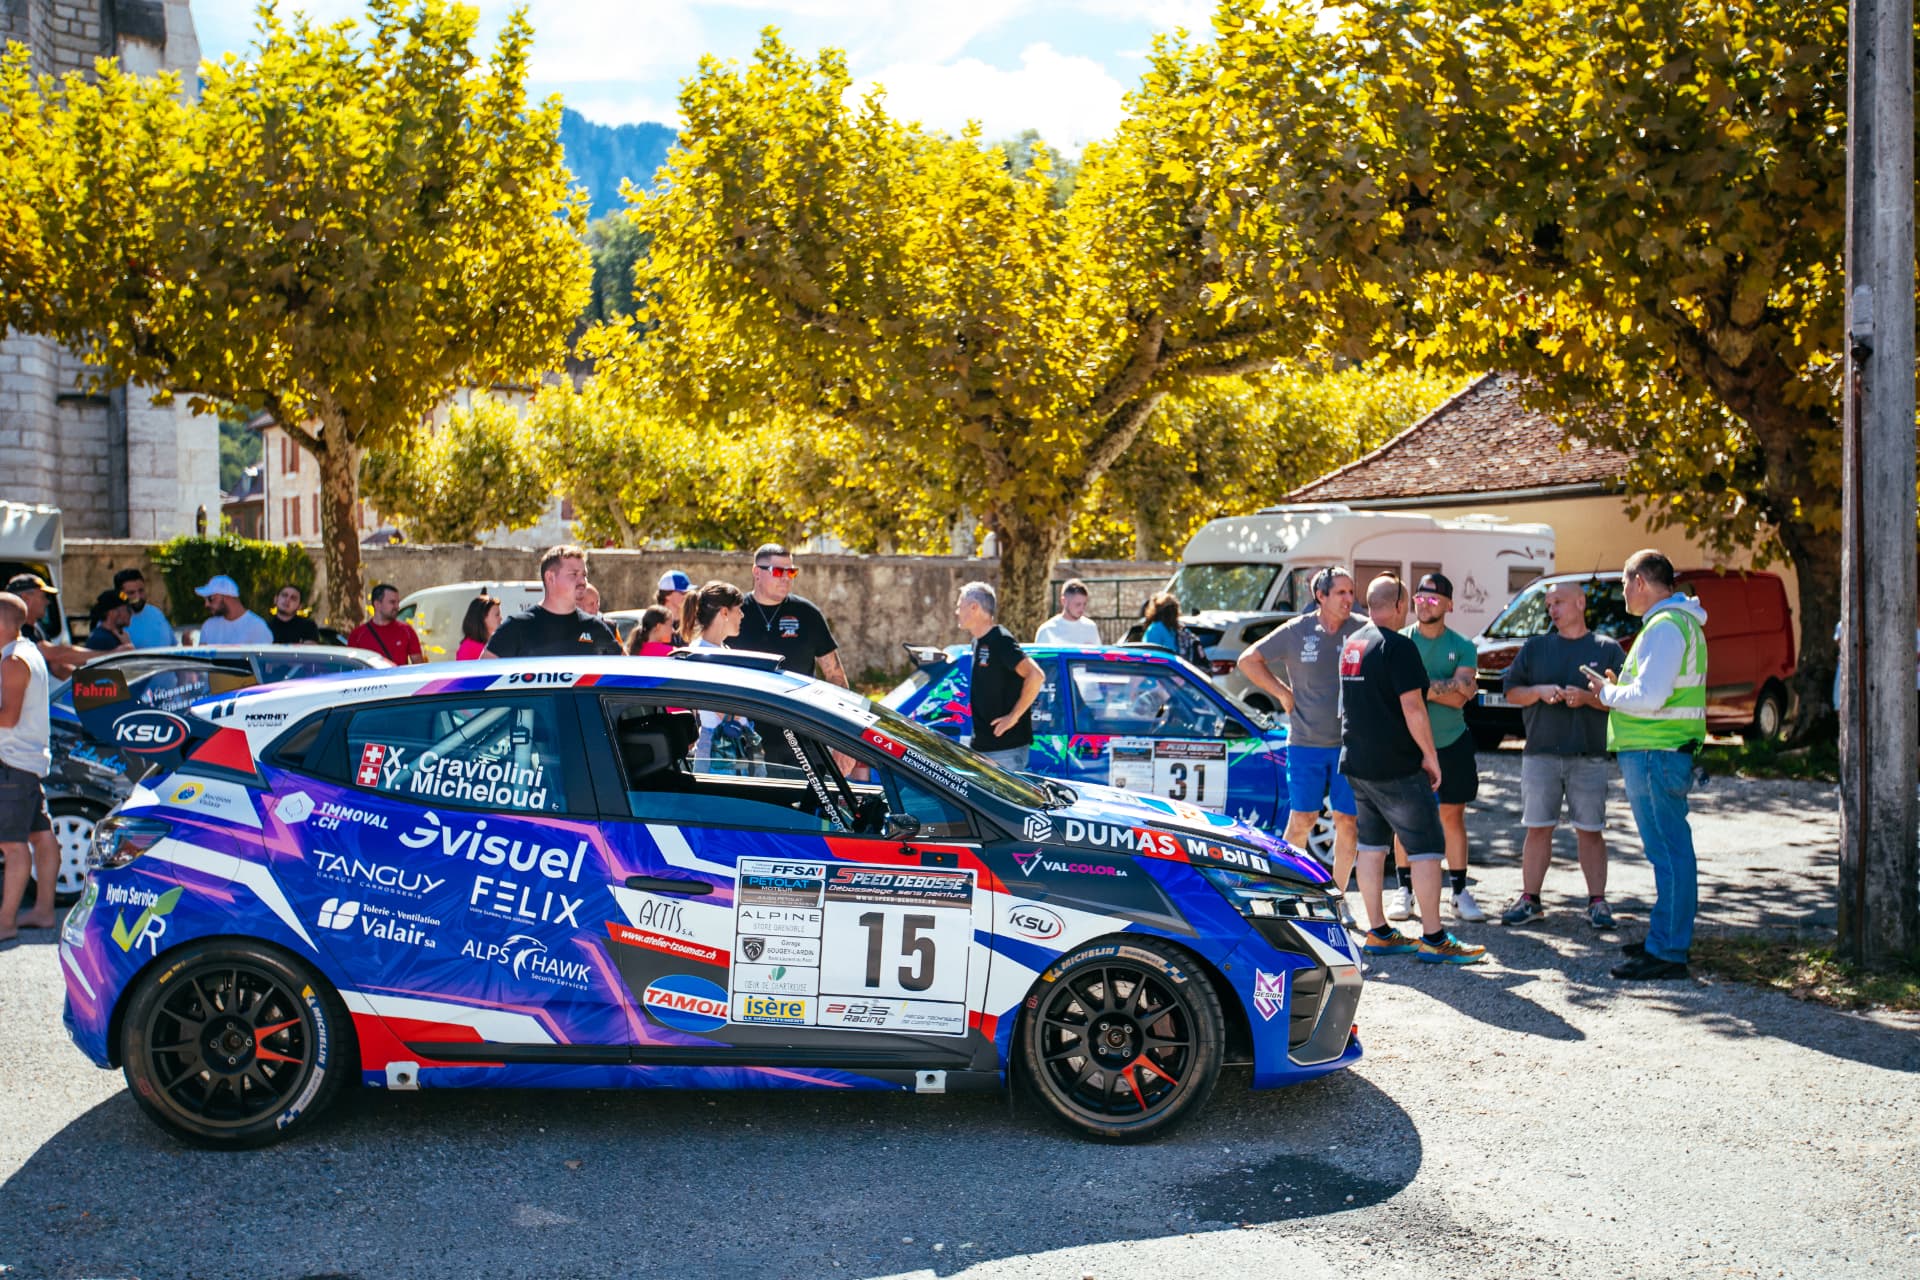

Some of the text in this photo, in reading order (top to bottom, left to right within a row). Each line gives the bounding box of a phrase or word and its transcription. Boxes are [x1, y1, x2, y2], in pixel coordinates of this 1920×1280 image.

[116, 724, 173, 743] KSU
[384, 746, 543, 788] X. Craviolini
[791, 744, 812, 772] AUTO
[805, 770, 830, 805] LEMAN
[902, 755, 950, 788] RENOVATION
[906, 749, 963, 785] CONSTRUCTION
[384, 768, 546, 810] Y. Micheloud
[1169, 762, 1205, 802] 31
[312, 816, 340, 831] .CH
[320, 802, 389, 830] IMMOVAL
[1066, 820, 1176, 856] DUMAS
[1186, 838, 1248, 866] Mobil
[313, 849, 446, 894] TANGUY
[749, 877, 809, 888] PETOLAT
[772, 864, 817, 876] FFSA
[829, 868, 966, 890] SPEED DEBOSSE
[1042, 860, 1117, 877] VALCOLOR
[106, 883, 158, 908] Hydro Service
[470, 875, 584, 928] FELIX
[363, 904, 390, 916] Tolerie
[397, 910, 440, 926] Ventilation
[741, 910, 820, 922] ALPINE
[1009, 910, 1054, 935] KSU
[362, 915, 425, 945] Valair
[461, 940, 592, 982] ALPS HAWK
[859, 912, 936, 991] 15
[1060, 946, 1115, 970] MICHELIN
[531, 973, 588, 990] Security Services
[646, 988, 728, 1018] TAMOIL
[746, 995, 802, 1016] isère
[843, 1014, 886, 1026] Racing
[312, 1006, 326, 1065] MICHELIN
